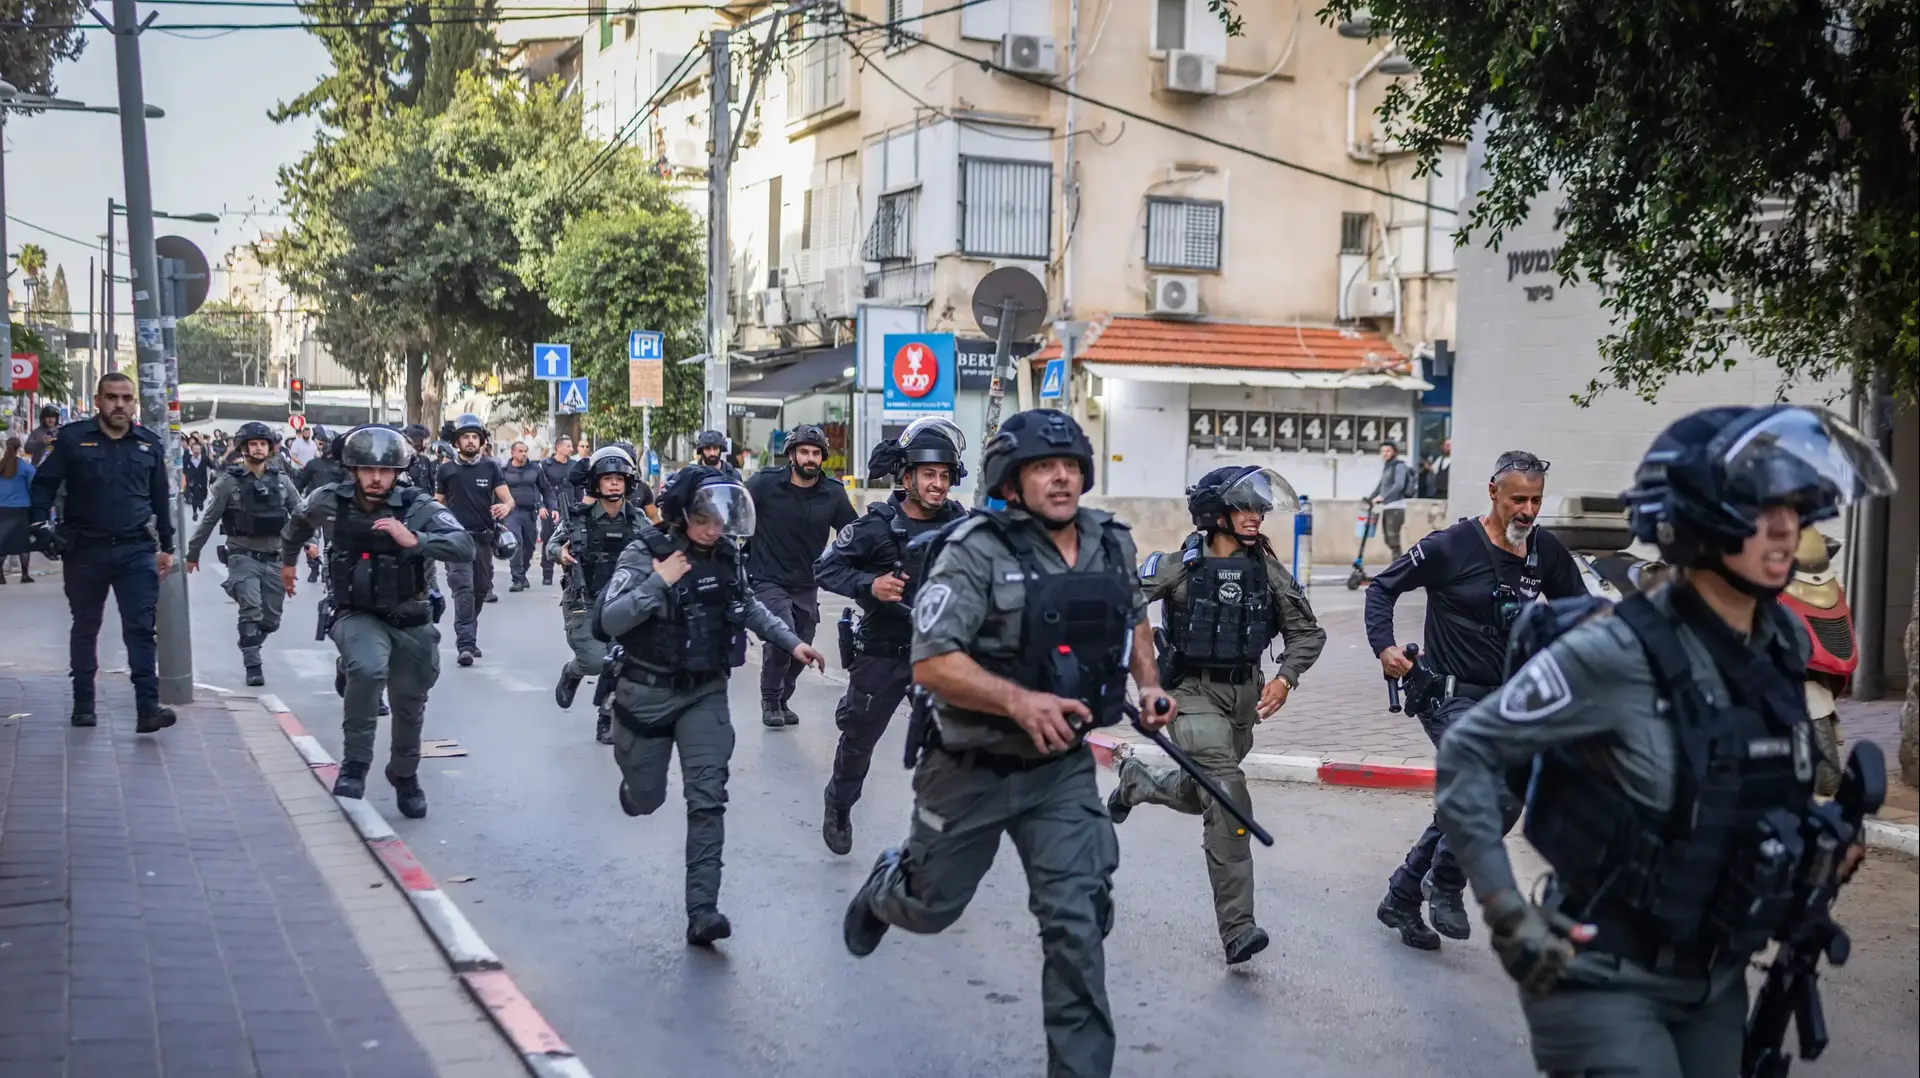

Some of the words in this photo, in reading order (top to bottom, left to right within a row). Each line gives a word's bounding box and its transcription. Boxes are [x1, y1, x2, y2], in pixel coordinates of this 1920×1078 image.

[958, 352, 1019, 368] BERTN
[1194, 414, 1211, 435] 4
[1222, 415, 1238, 436] 4
[1251, 416, 1267, 437] 4
[1278, 417, 1295, 438] 4
[1305, 418, 1322, 439] 4
[1334, 419, 1351, 440] 4
[1361, 420, 1377, 441] 4
[1388, 422, 1403, 441] 4
[1218, 572, 1241, 580] MASTER
